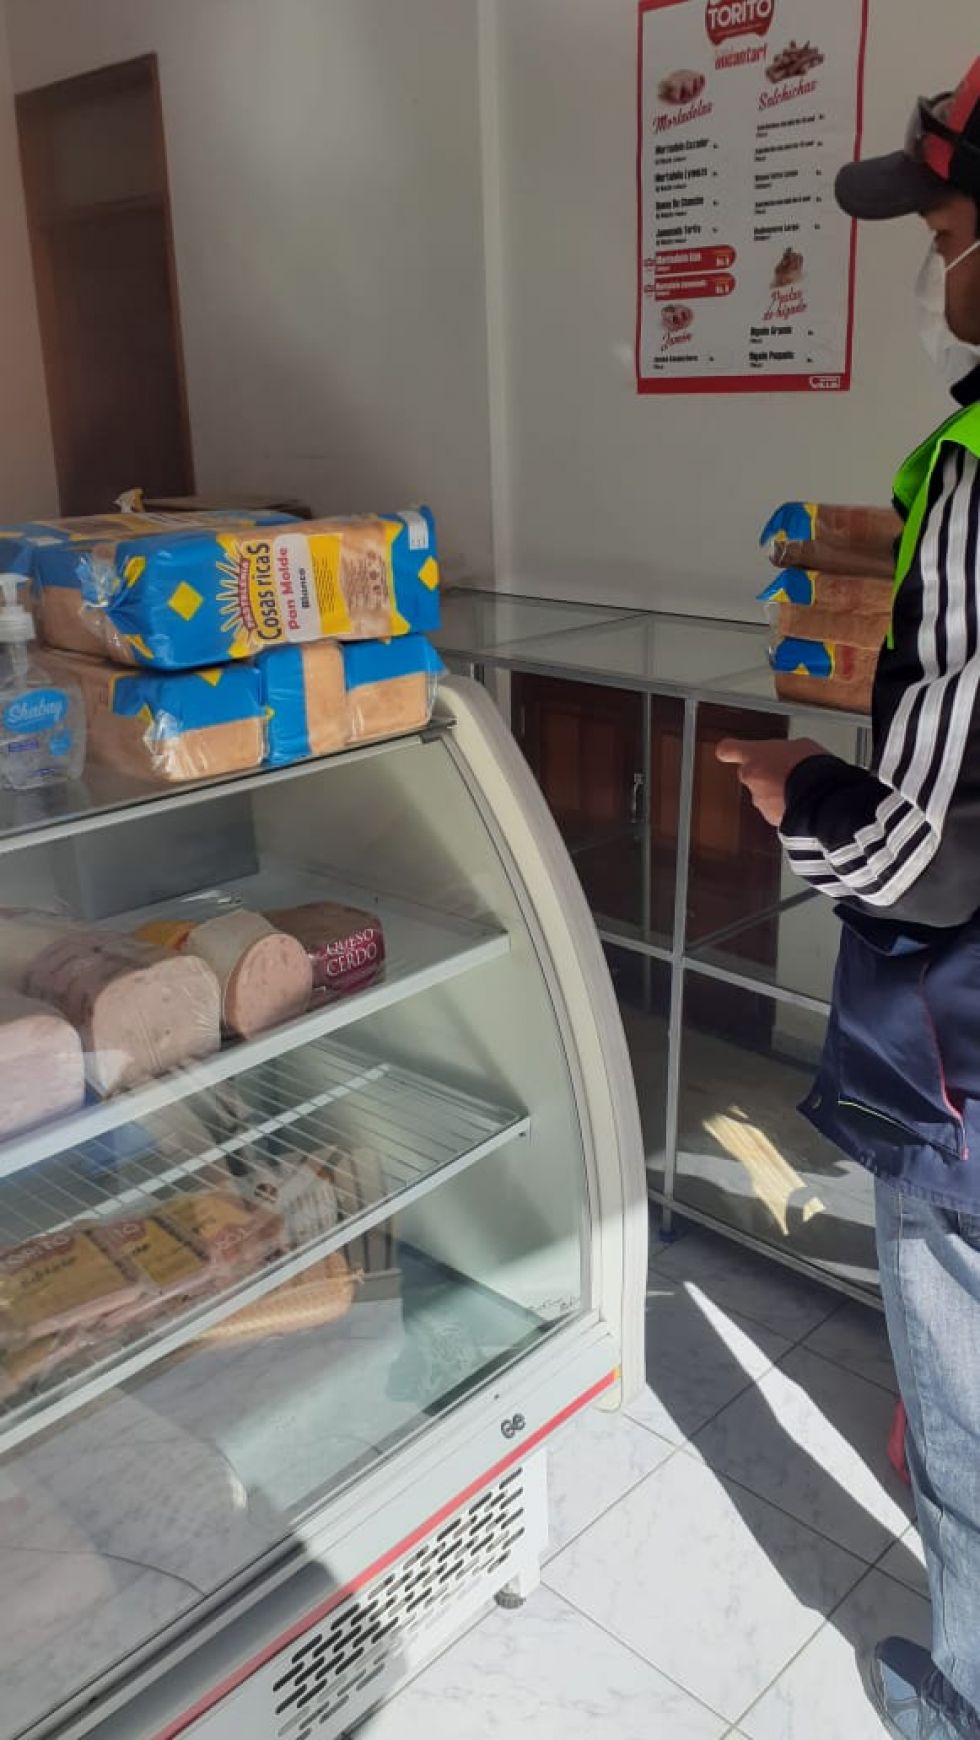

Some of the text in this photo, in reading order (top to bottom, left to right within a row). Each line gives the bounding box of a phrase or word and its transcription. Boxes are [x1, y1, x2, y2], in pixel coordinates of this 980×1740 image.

[707, 0, 772, 30] TORITO
[758, 80, 818, 111] Salchichas
[652, 101, 713, 134] Mortadelas
[277, 547, 300, 630] Pan Molde
[300, 568, 310, 608] Blanco
[257, 590, 282, 639] Cosas
[325, 928, 374, 957] QUESO
[326, 942, 377, 977] CERDO
